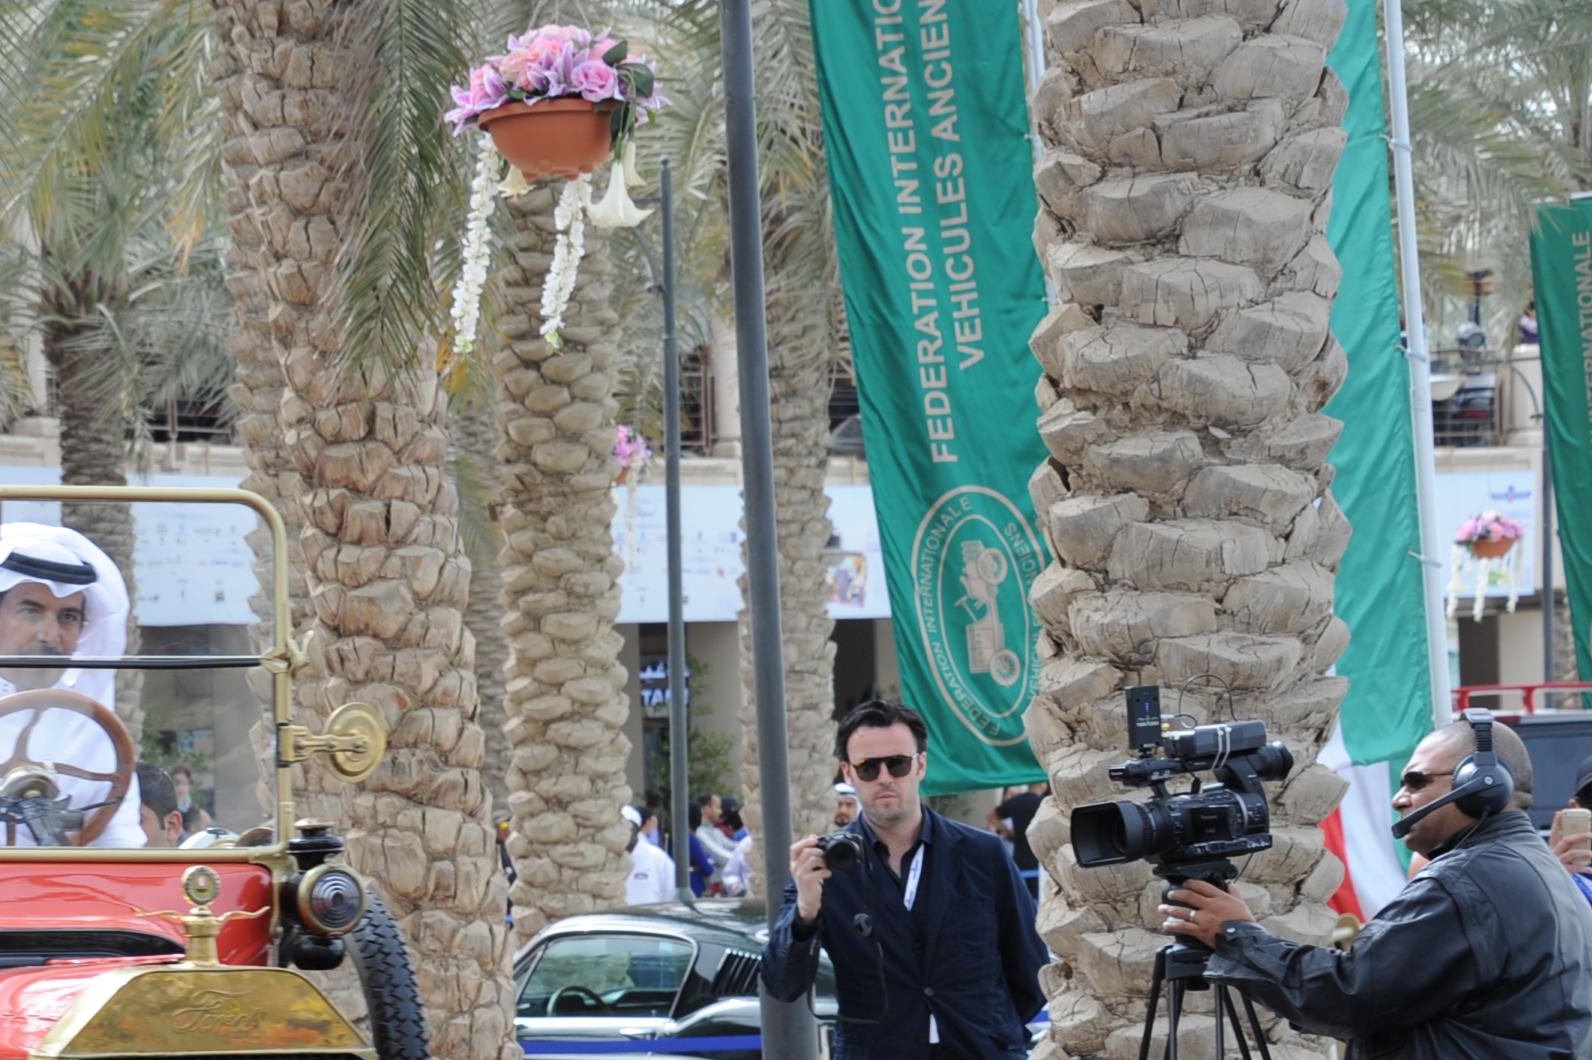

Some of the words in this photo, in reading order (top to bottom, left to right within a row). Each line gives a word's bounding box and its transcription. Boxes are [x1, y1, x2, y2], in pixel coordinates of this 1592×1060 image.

[933, 152, 985, 370] VEHICULES
[901, 227, 958, 464] FEDERATION
[919, 497, 973, 634] INTERNATIONALE
[933, 641, 1001, 737] FEDERATION
[172, 989, 266, 1034] Ford
